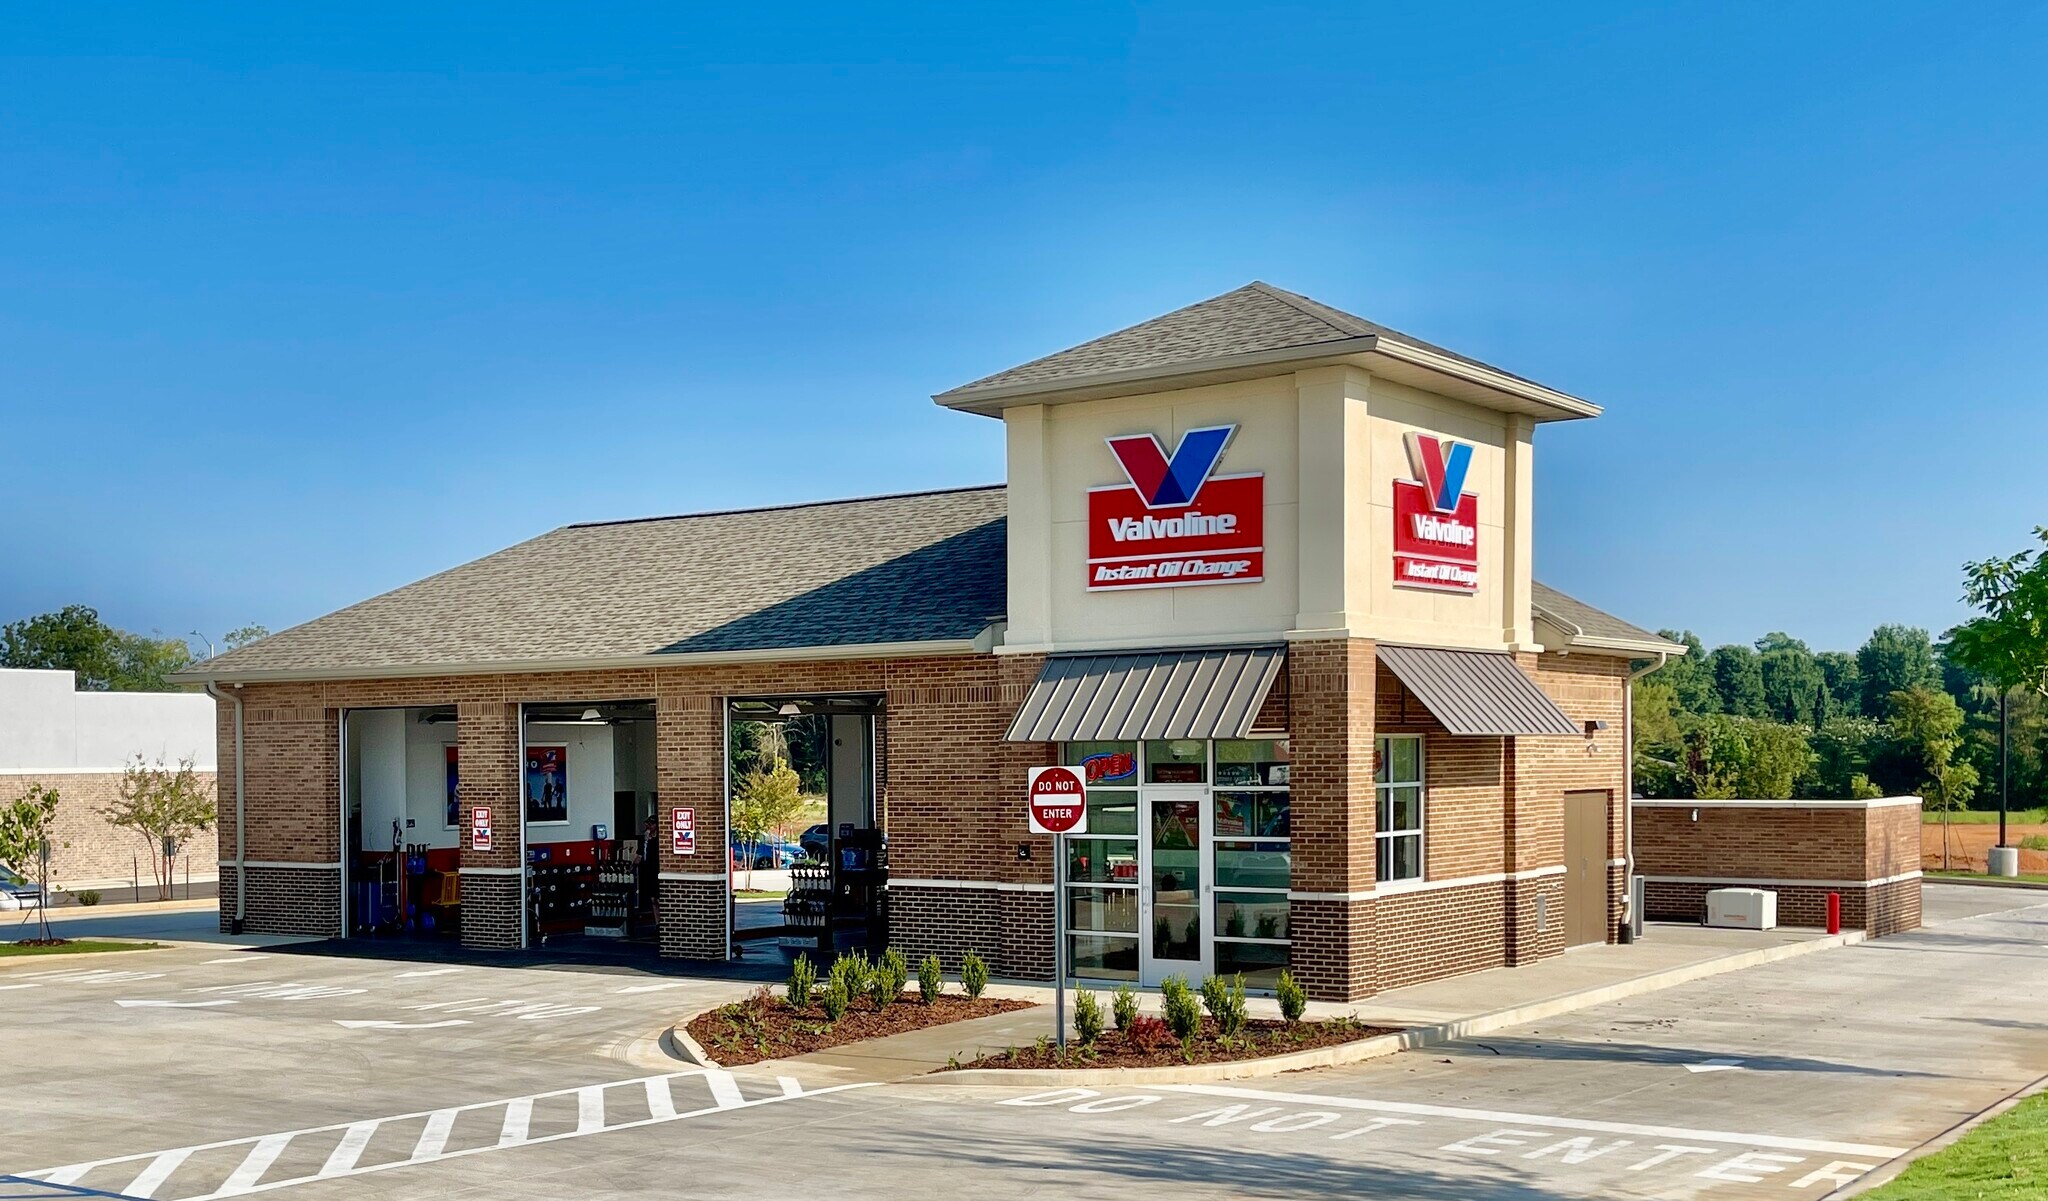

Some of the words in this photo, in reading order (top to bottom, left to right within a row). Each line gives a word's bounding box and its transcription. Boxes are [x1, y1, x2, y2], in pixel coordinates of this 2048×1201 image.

[1107, 511, 1237, 542] Valvoline
[1412, 513, 1475, 546] Valvoline
[1094, 563, 1157, 581] Instant
[1157, 561, 1184, 577] Oil
[1181, 560, 1251, 577] Change
[1407, 561, 1439, 579] Instant
[1086, 752, 1132, 781] OPEN
[1038, 781, 1052, 791] DO
[1055, 781, 1075, 791] NOT
[475, 810, 488, 818] EXIT
[677, 811, 691, 820] EXIT
[1043, 809, 1072, 819] ENTER
[475, 819, 489, 827] ONLY
[676, 820, 691, 829] ONLY
[994, 1088, 1163, 1114] DO
[1167, 1103, 1427, 1141] NOT
[1437, 1128, 1878, 1194] ENTER
